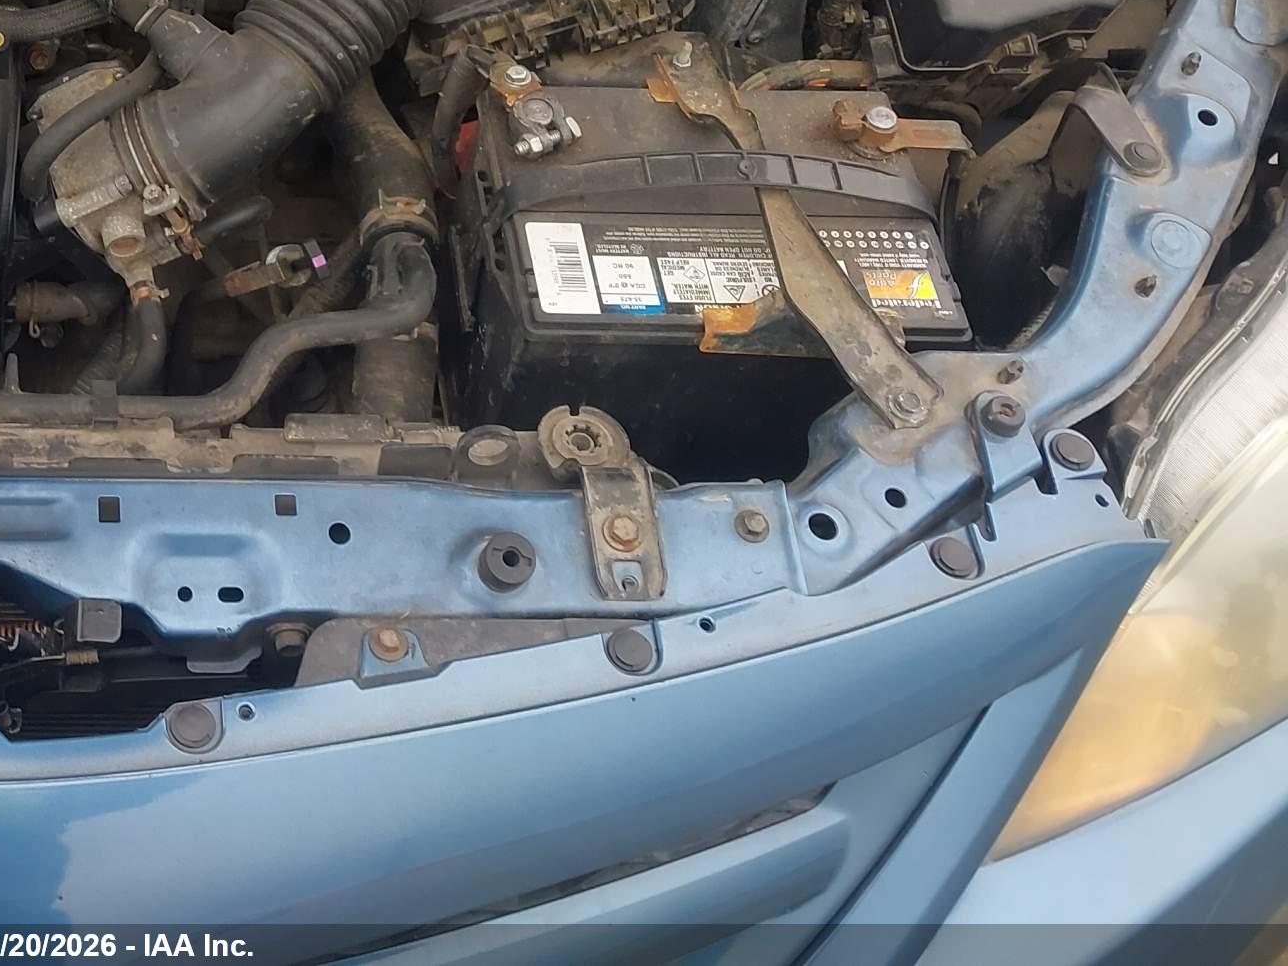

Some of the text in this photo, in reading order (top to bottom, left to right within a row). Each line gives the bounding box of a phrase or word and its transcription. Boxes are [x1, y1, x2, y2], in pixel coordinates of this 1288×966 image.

[865, 271, 897, 280] Parts
[869, 279, 896, 288] Auto
[871, 298, 941, 309] Federated
